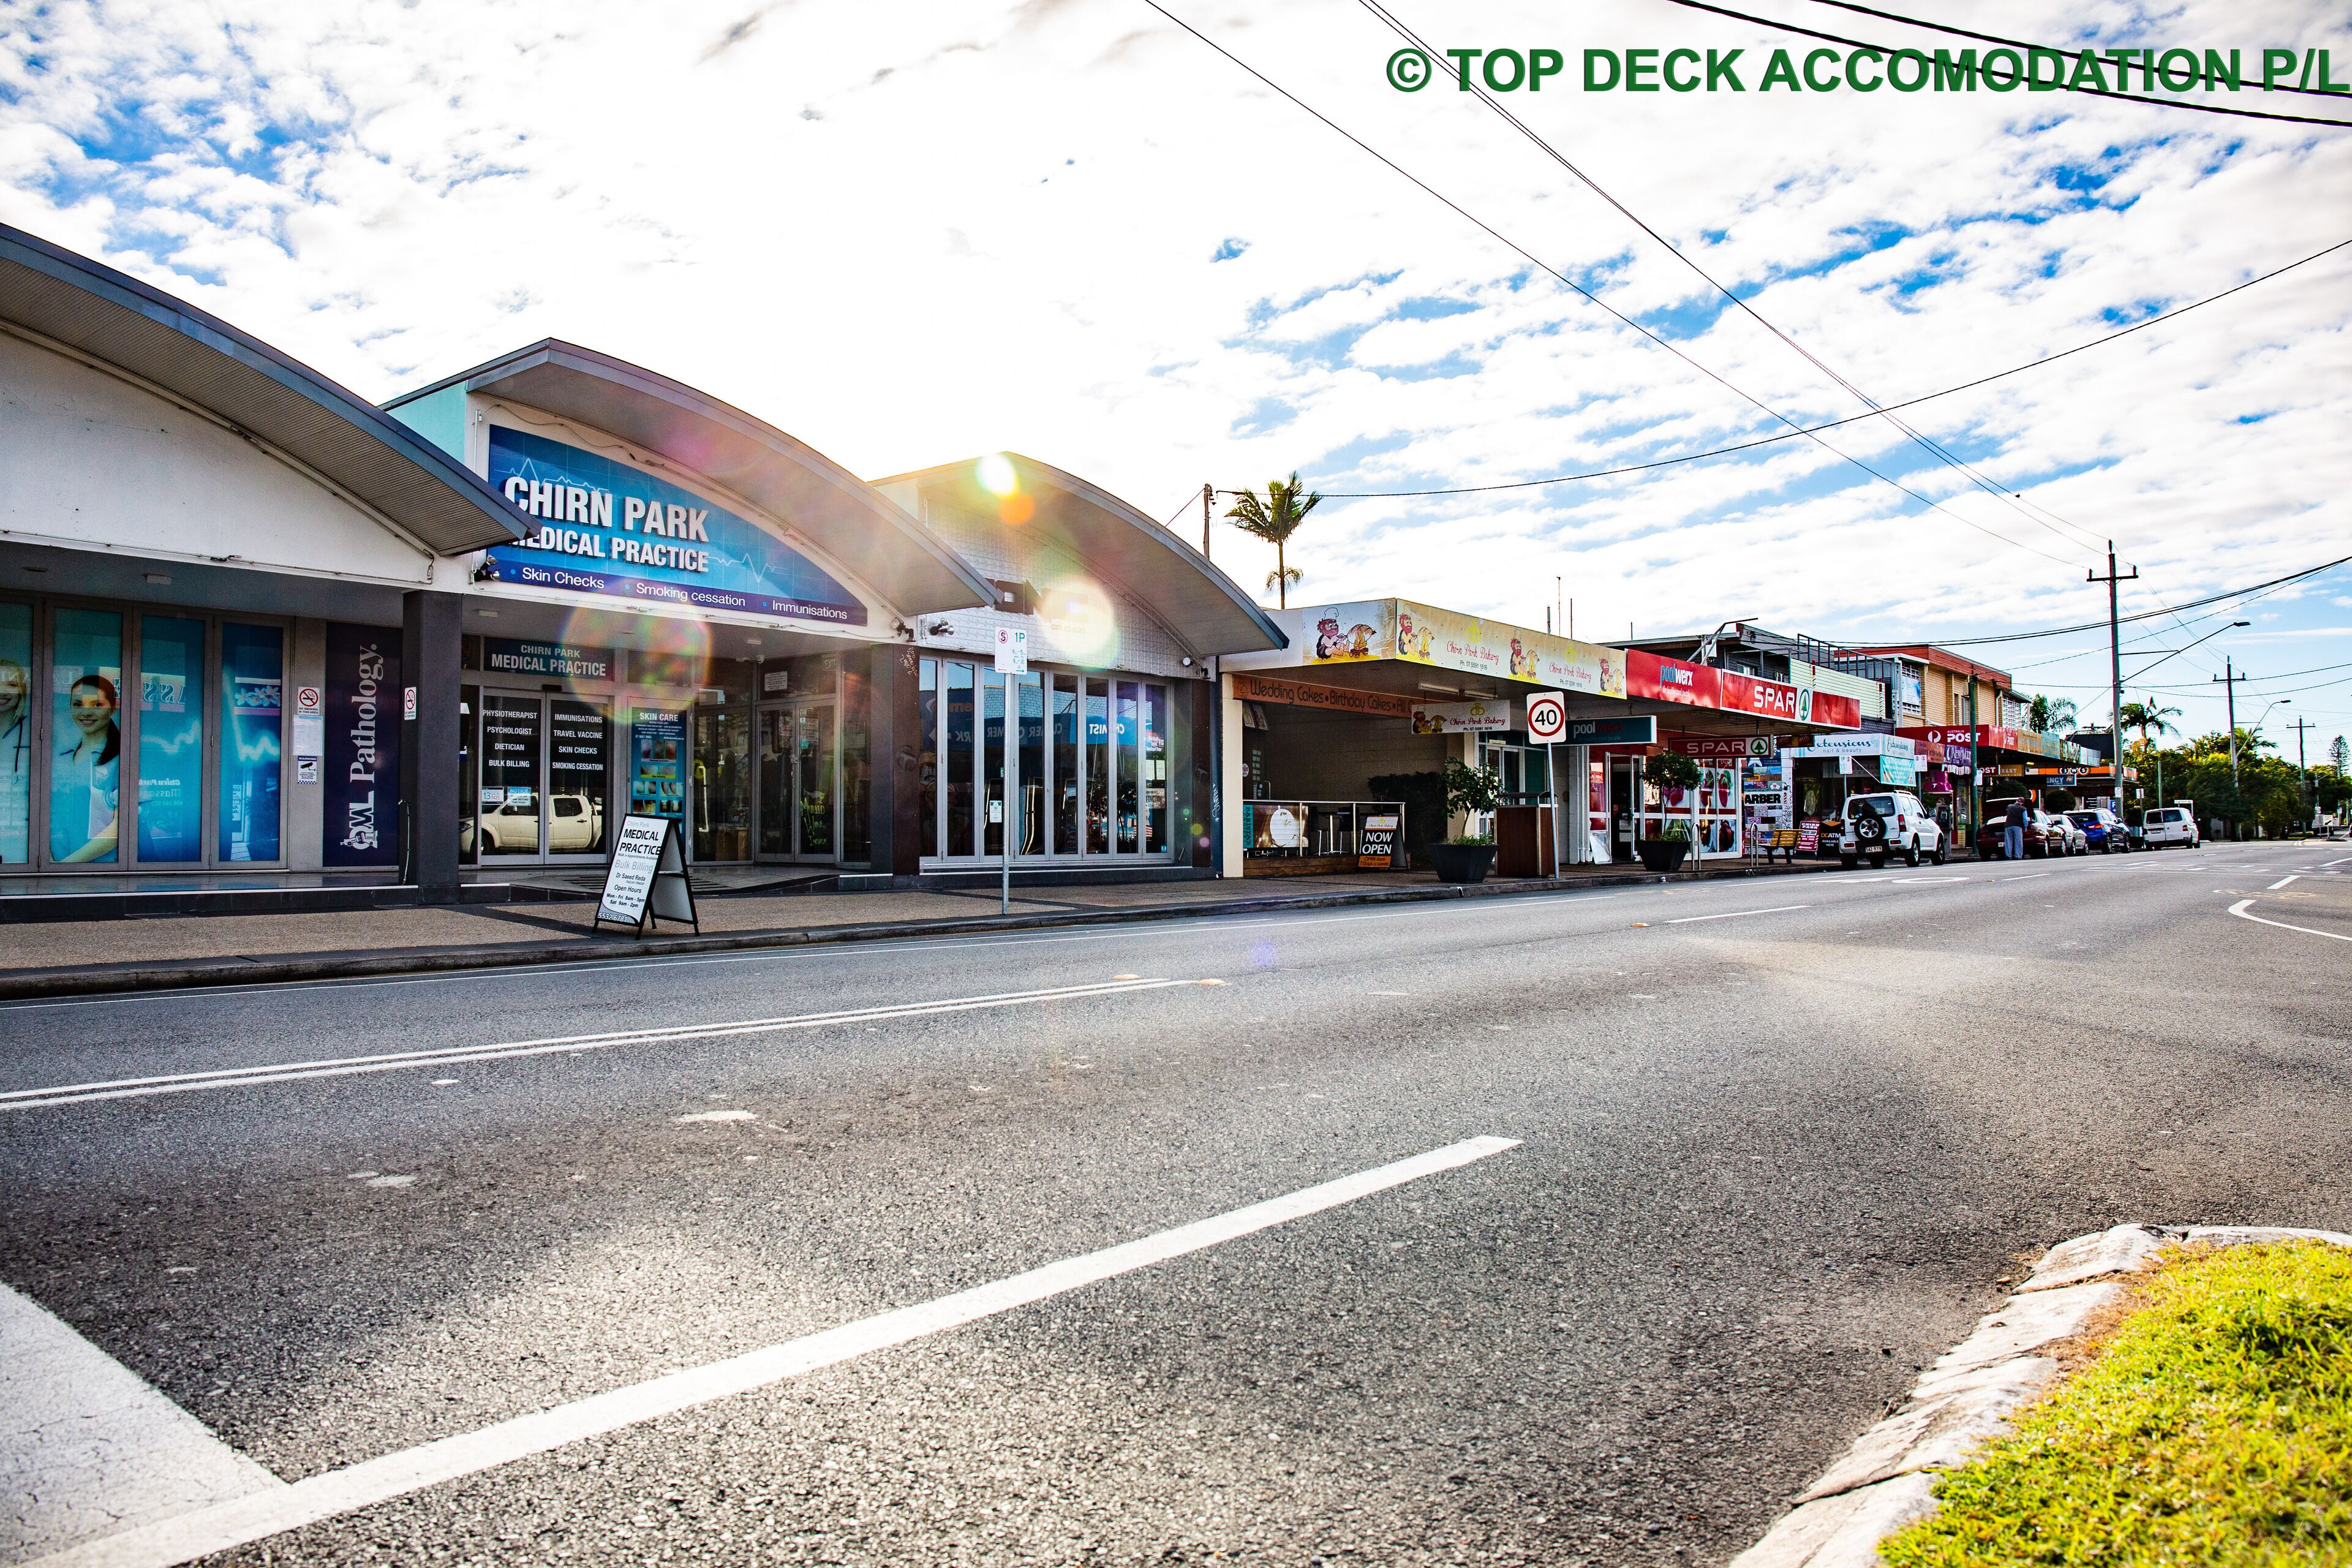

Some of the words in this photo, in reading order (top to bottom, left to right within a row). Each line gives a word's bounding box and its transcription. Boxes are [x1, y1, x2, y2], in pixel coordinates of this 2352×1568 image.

[505, 476, 612, 527] CHIRN
[624, 497, 710, 543] PARK
[508, 526, 605, 559] EDICAL
[612, 537, 709, 573] PRACTICE
[522, 567, 551, 584] Skin
[554, 571, 605, 590] Checks
[636, 583, 688, 603] Smoking
[690, 590, 746, 608] cessation
[772, 599, 848, 620] Immunisations
[1015, 632, 1025, 643] 1P
[521, 645, 551, 655] CHIRN
[554, 648, 581, 658] PARK
[1446, 640, 1463, 655] Chirn
[1464, 644, 1478, 658] Park
[1479, 647, 1499, 664] Bakery
[491, 654, 546, 671] MEDICAL
[550, 659, 606, 676] PRACTICE
[1548, 662, 1562, 674] Chirn
[1563, 664, 1575, 677] Park
[1576, 666, 1592, 682] Bakery
[1660, 663, 1693, 688] poolwerx
[1250, 679, 1294, 703] Wedding
[1297, 685, 1324, 703] Cakes
[1330, 691, 1365, 712] Birthday
[1368, 696, 1392, 712] Cakes
[1396, 699, 1406, 713] All
[1754, 685, 1795, 714] SPAR
[350, 644, 383, 783] Pathology.
[483, 709, 538, 719] PHYSIOTHERAPIST
[554, 714, 603, 723] IMMUNISATIONS
[639, 712, 657, 721] SKIN
[659, 714, 679, 722] CARE
[1534, 709, 1557, 726] 40
[1483, 717, 1506, 727] Bakery
[487, 726, 532, 735] PSYCHOLOGIST
[553, 729, 576, 738] TRAVEL
[577, 731, 603, 739] VACCINE
[1573, 721, 1623, 739] poolwerx
[1687, 741, 1744, 753] SPAR
[1745, 793, 1781, 804] ARBER
[349, 790, 379, 850] QML
[624, 829, 659, 841] MEDICAL
[1366, 832, 1393, 842] NOW
[619, 842, 662, 855] PRACTICE
[1362, 844, 1392, 854] OPEN
[615, 859, 630, 869] Bulk
[631, 861, 654, 874] Billing
[613, 914, 627, 922] 6781
